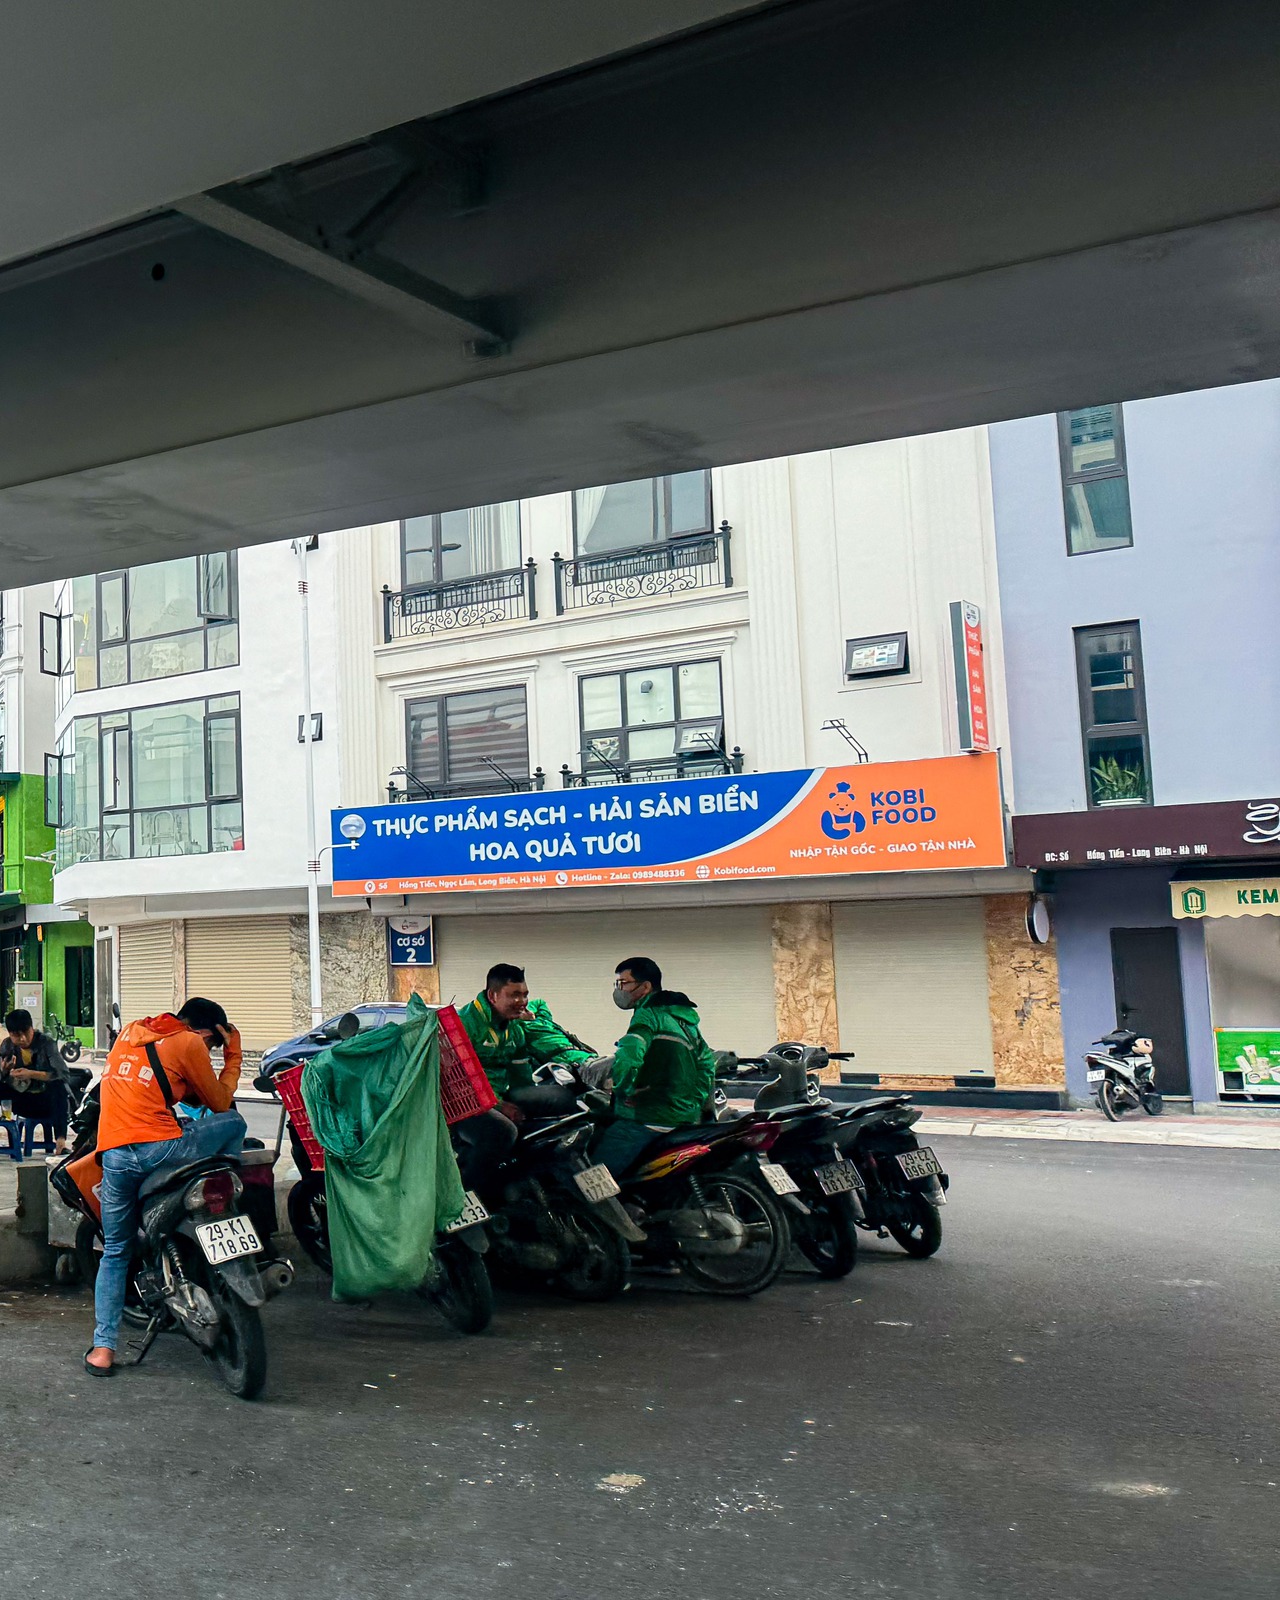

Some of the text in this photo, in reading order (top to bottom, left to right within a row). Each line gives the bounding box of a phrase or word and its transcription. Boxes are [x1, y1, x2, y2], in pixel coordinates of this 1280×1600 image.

[871, 788, 925, 807] KOBI
[372, 814, 429, 839] THỰC
[434, 805, 498, 833] PHẨM
[504, 805, 566, 832] SẠCH
[589, 796, 632, 822] HẢI
[639, 792, 691, 818] SẢN
[699, 784, 758, 814] BIỂN
[872, 806, 936, 825] FOOD
[470, 831, 641, 863] HOA QUẢ TƯƠI
[790, 846, 821, 859] NHẬP
[825, 844, 848, 858] TẬN
[851, 842, 876, 854] GỐC
[887, 842, 917, 853] GIAO
[920, 839, 945, 854] TẬN
[948, 836, 976, 849] NHÀ
[1132, 848, 1151, 858] Long
[571, 873, 602, 882] Hotline
[609, 872, 630, 880] Zalo:
[714, 865, 776, 876] Kobifood.com
[478, 878, 497, 886] Long
[1237, 889, 1279, 905] KEM
[406, 947, 417, 963] 2
[905, 1161, 938, 1178] 096.07
[205, 1218, 246, 1242] 29-K1
[208, 1234, 258, 1260] 718.69
